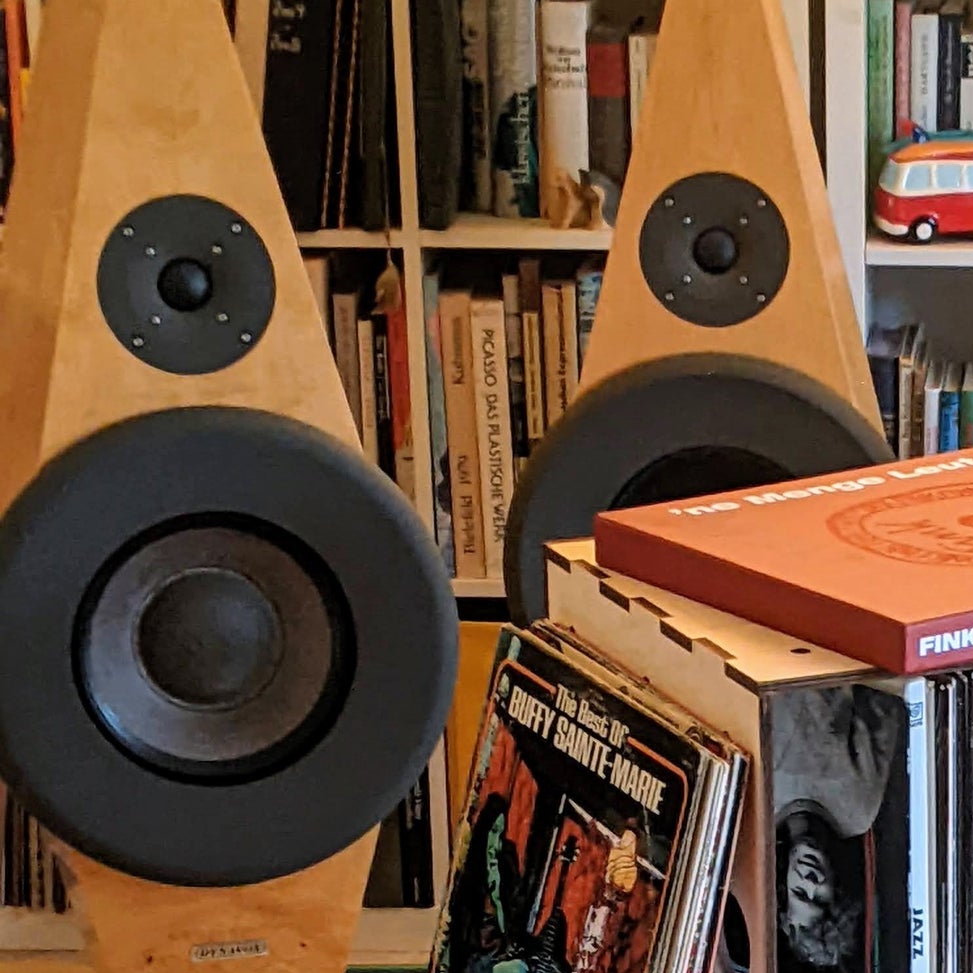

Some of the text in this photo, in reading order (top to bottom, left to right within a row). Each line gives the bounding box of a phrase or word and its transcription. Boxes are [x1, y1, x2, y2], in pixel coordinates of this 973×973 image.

[482, 329, 497, 387] PICASSO
[485, 393, 498, 419] DAS
[487, 423, 505, 500] PLASTISCHE
[743, 473, 887, 506] Menge
[507, 685, 556, 740] BUFFY
[555, 683, 579, 718] The
[578, 700, 610, 737] Best
[912, 908, 925, 960] JAZZ
